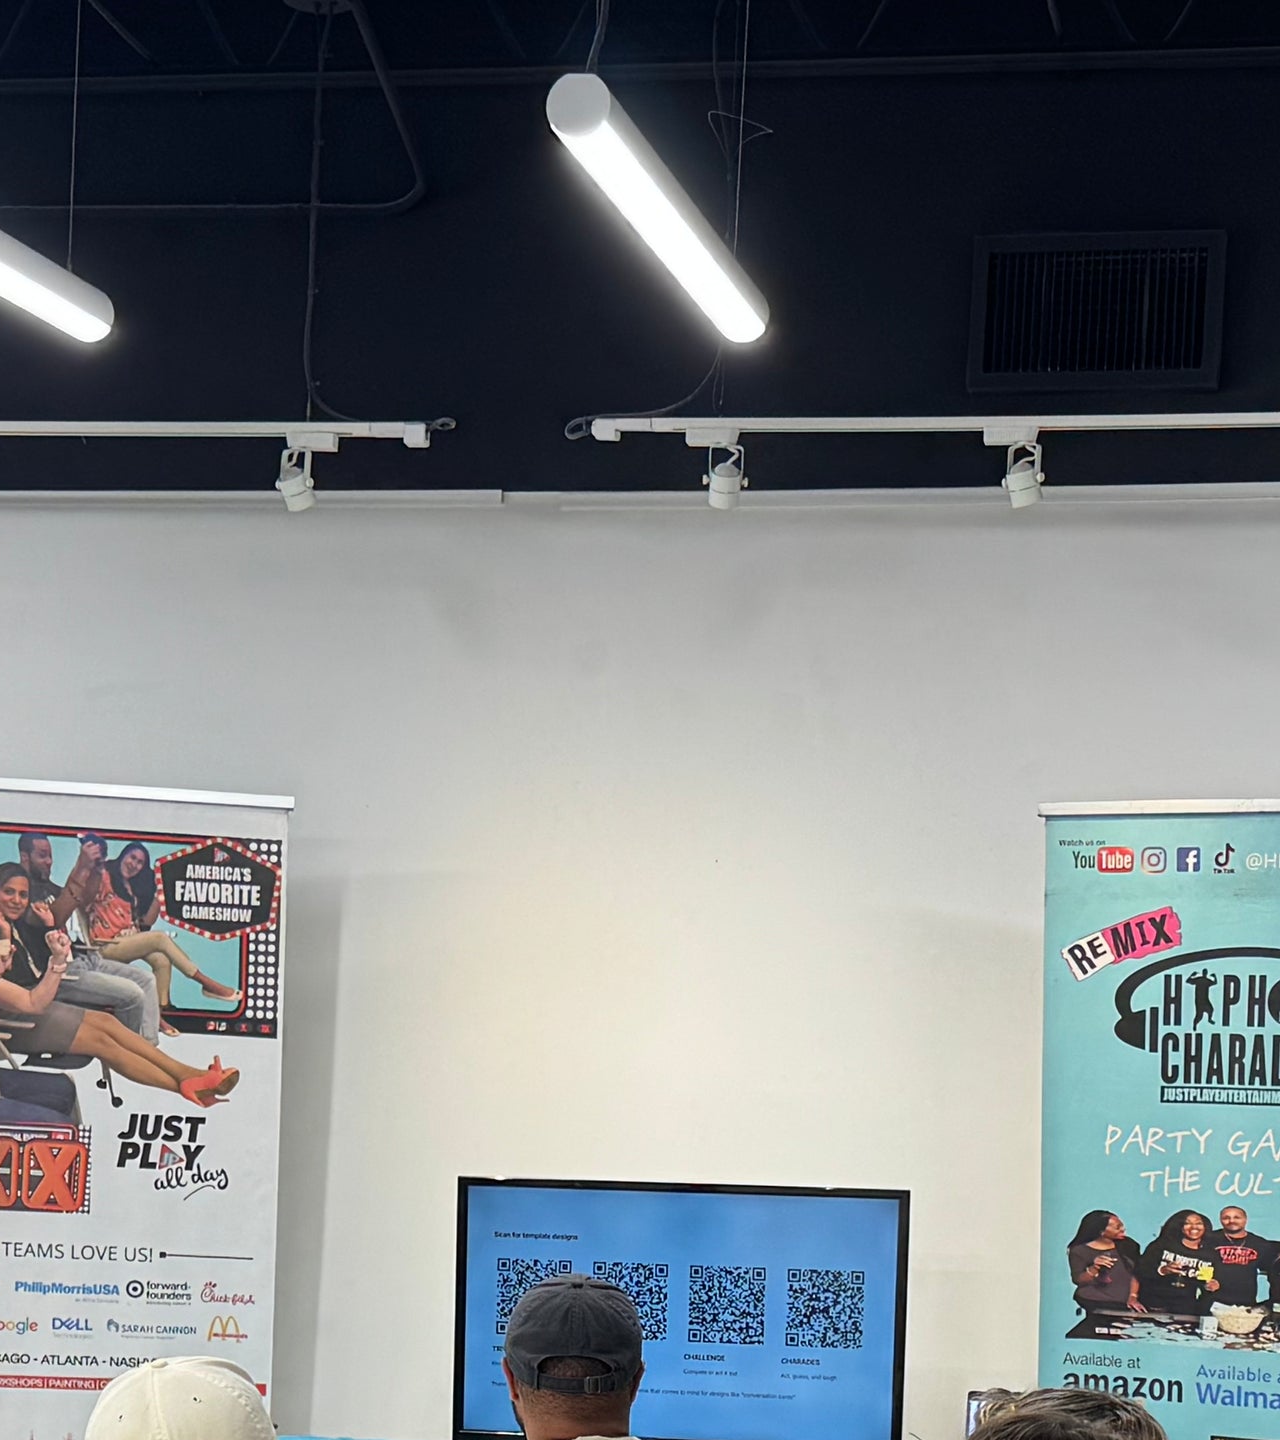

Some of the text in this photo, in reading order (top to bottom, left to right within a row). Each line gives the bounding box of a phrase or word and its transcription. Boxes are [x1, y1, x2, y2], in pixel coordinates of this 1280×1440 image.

[185, 864, 252, 882] AMERICA'S
[174, 880, 261, 906] FAVORITE
[182, 905, 252, 922] GAMESHOW
[1067, 913, 1173, 976] REMIX
[117, 1113, 207, 1143] JUST
[1104, 1124, 1213, 1157] PARTY
[154, 1162, 229, 1191] all day
[1140, 1166, 1201, 1197] THE
[494, 1231, 578, 1241] Scan for template designs
[1, 1241, 153, 1263] TEAMS LOVE US!
[14, 1281, 120, 1296] PhilipMorrisUSA
[146, 1291, 192, 1301] founders
[51, 1317, 93, 1332] DELL
[121, 1324, 197, 1335] SARAH CANNON
[40, 1354, 99, 1368] ATLANTA
[1063, 1352, 1141, 1369] Available at
[1196, 1364, 1272, 1384] Available
[48, 1379, 95, 1389] PAINTING
[1063, 1372, 1183, 1403] amazon
